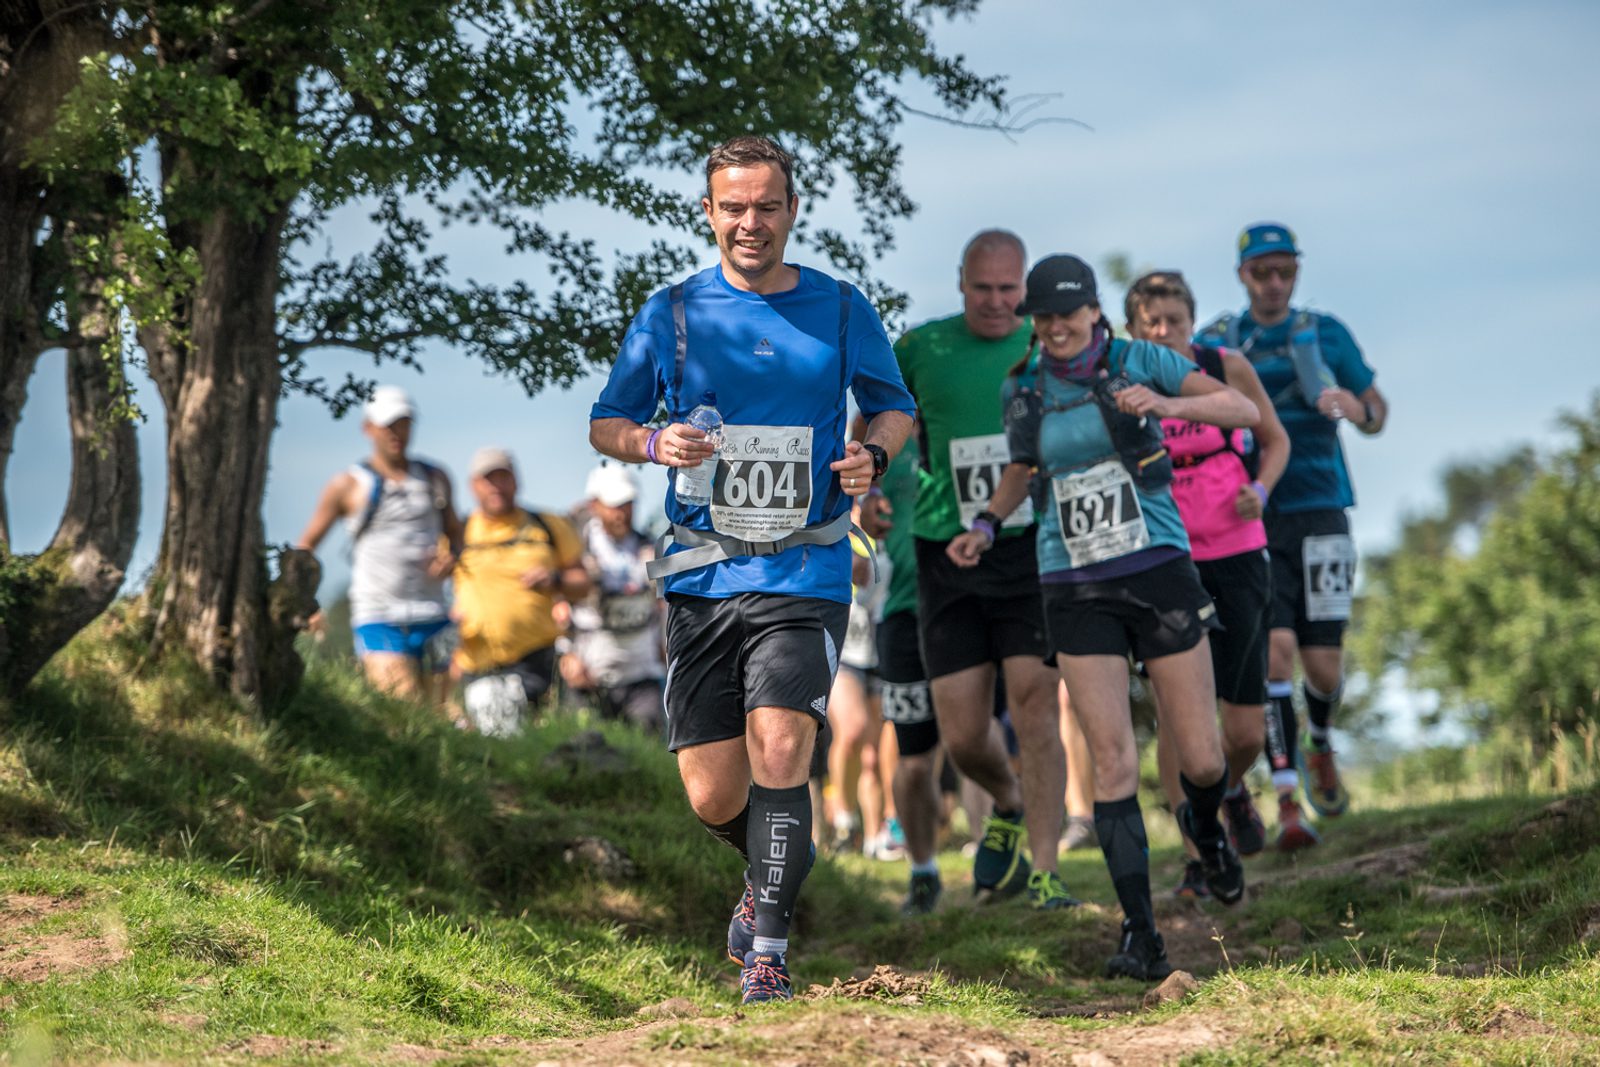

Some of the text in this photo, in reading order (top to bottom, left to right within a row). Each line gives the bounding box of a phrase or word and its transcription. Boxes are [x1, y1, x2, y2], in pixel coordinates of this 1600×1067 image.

[744, 436, 780, 459] Running
[724, 461, 797, 508] 604
[1069, 485, 1122, 537] 627
